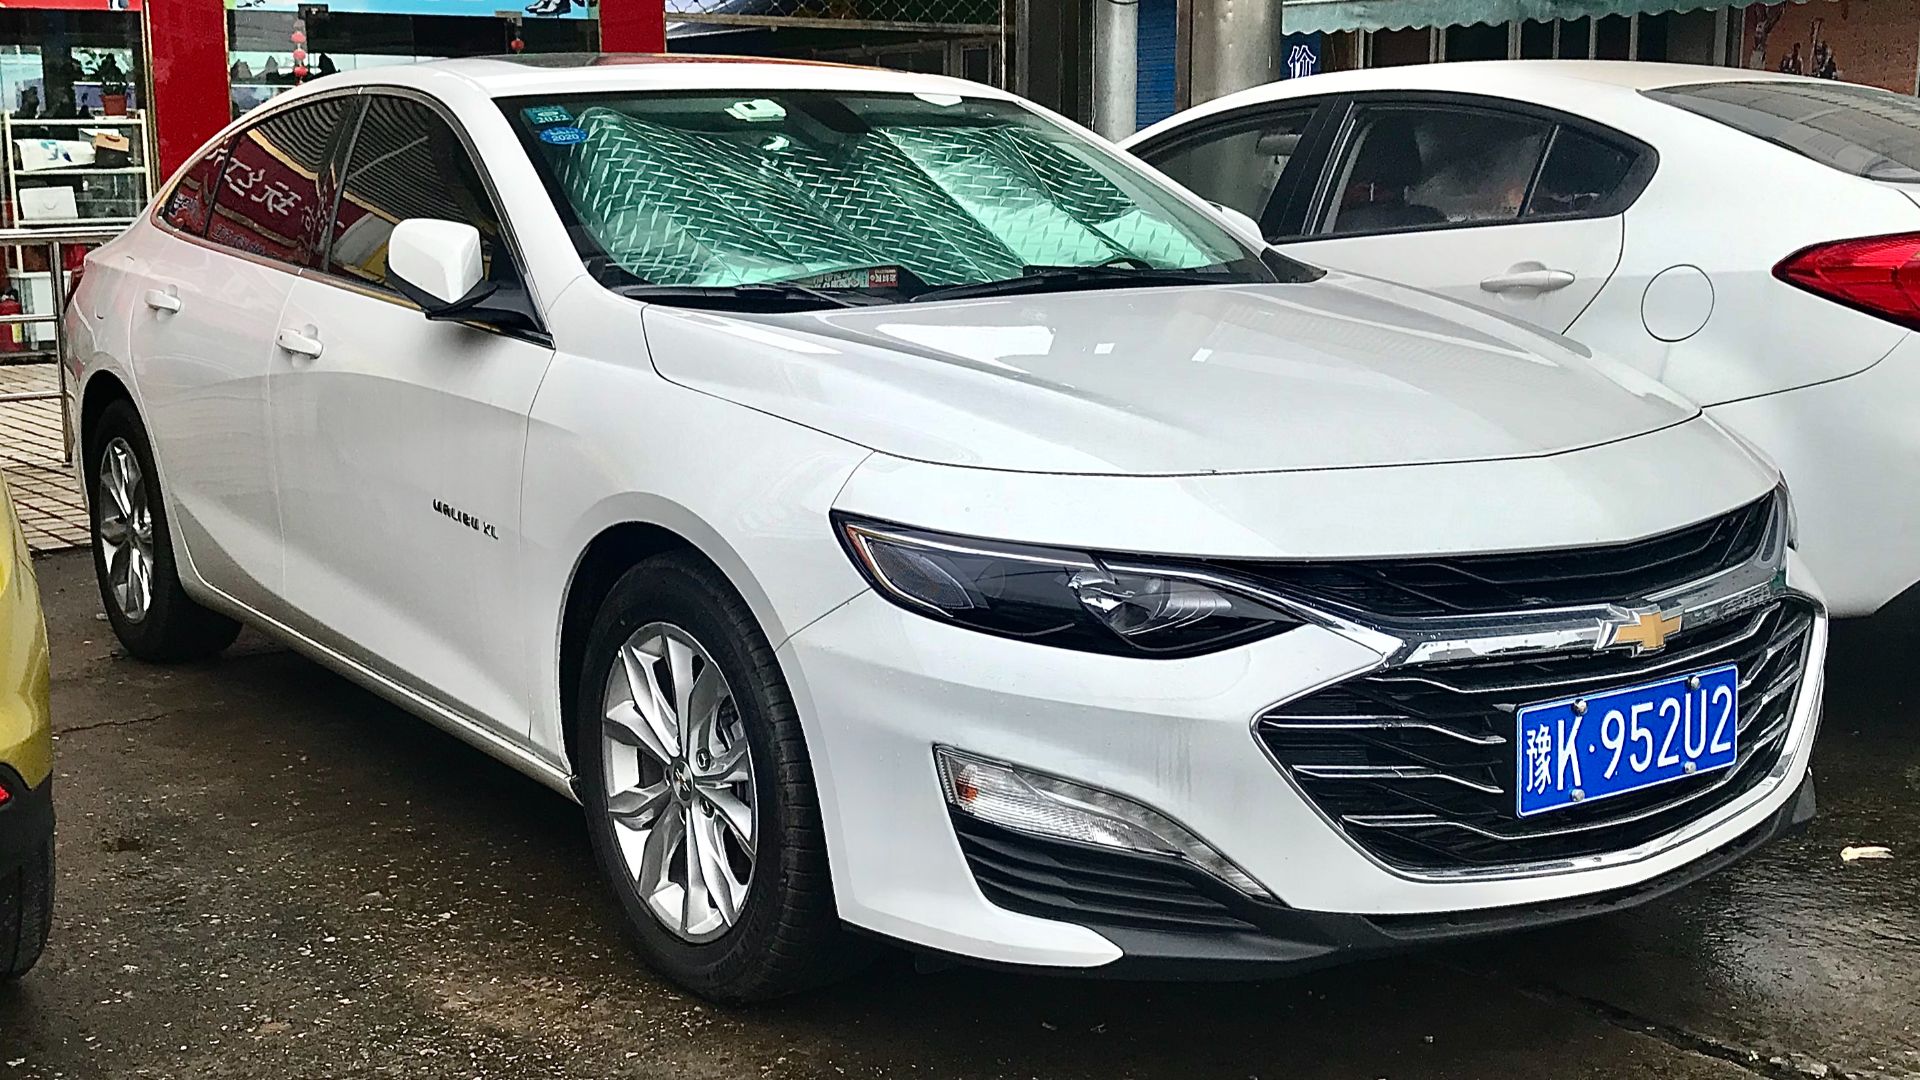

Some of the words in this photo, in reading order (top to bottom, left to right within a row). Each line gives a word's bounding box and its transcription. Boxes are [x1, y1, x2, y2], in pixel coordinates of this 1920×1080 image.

[550, 133, 580, 142] 2020
[432, 498, 480, 531] MALIBU
[483, 521, 499, 541] XL
